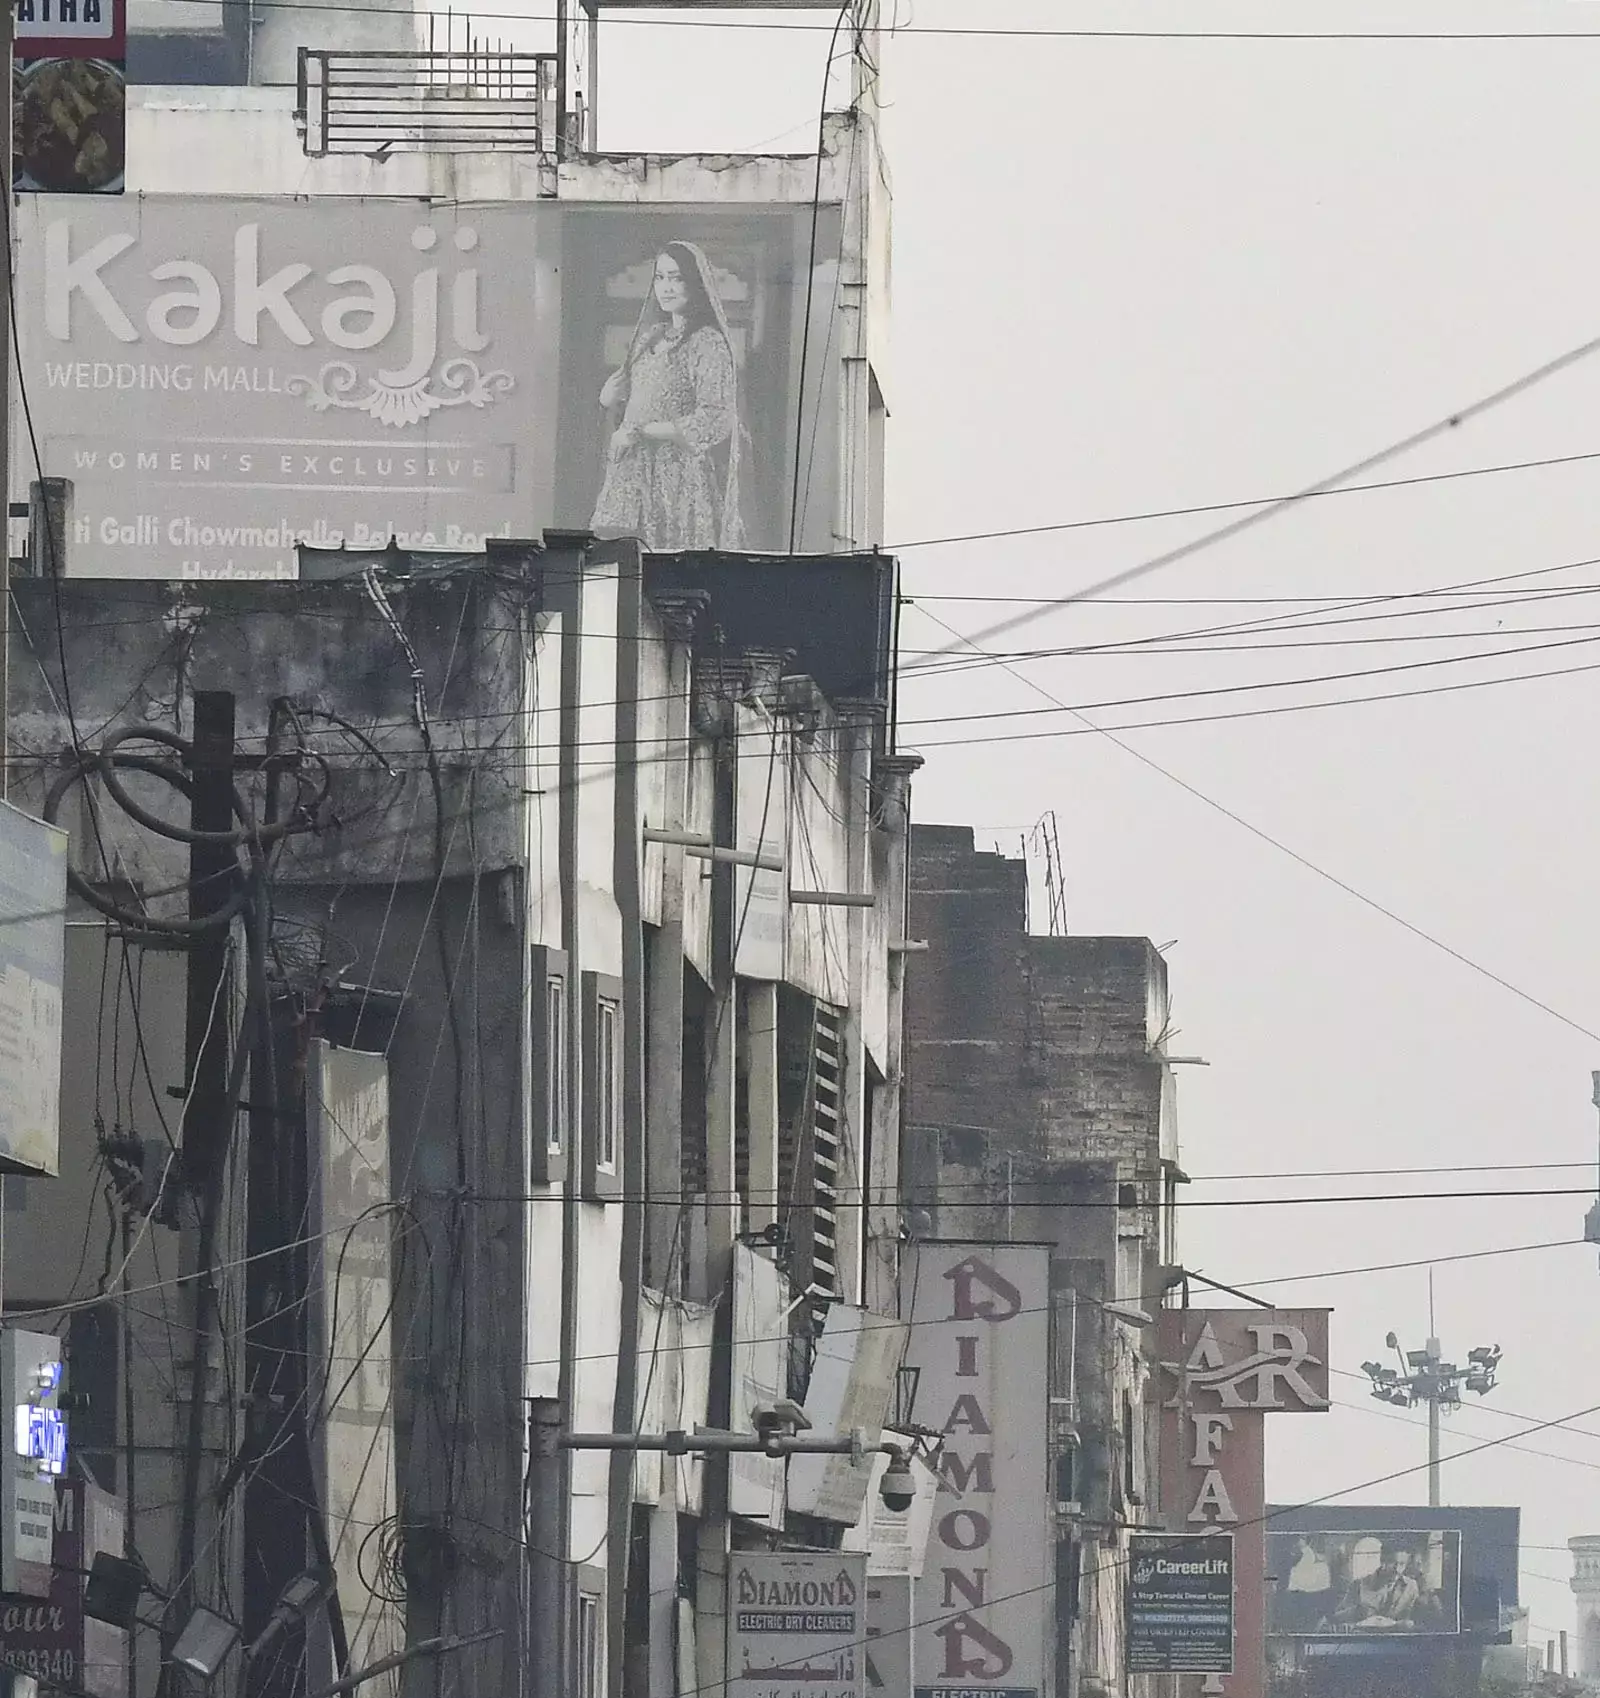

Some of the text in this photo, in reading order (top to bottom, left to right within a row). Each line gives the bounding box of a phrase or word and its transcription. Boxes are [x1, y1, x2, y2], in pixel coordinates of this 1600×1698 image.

[45, 362, 282, 393] WEDDING MALL
[73, 449, 487, 478] WOMEN'S EXCLUSIVE
[100, 517, 159, 545] Galli
[1160, 1320, 1331, 1409] AR
[1156, 1558, 1229, 1575] CareerLift
[737, 1567, 857, 1606] DIAMOND
[739, 1615, 853, 1630] ELECTRIC DRY CLEANERS
